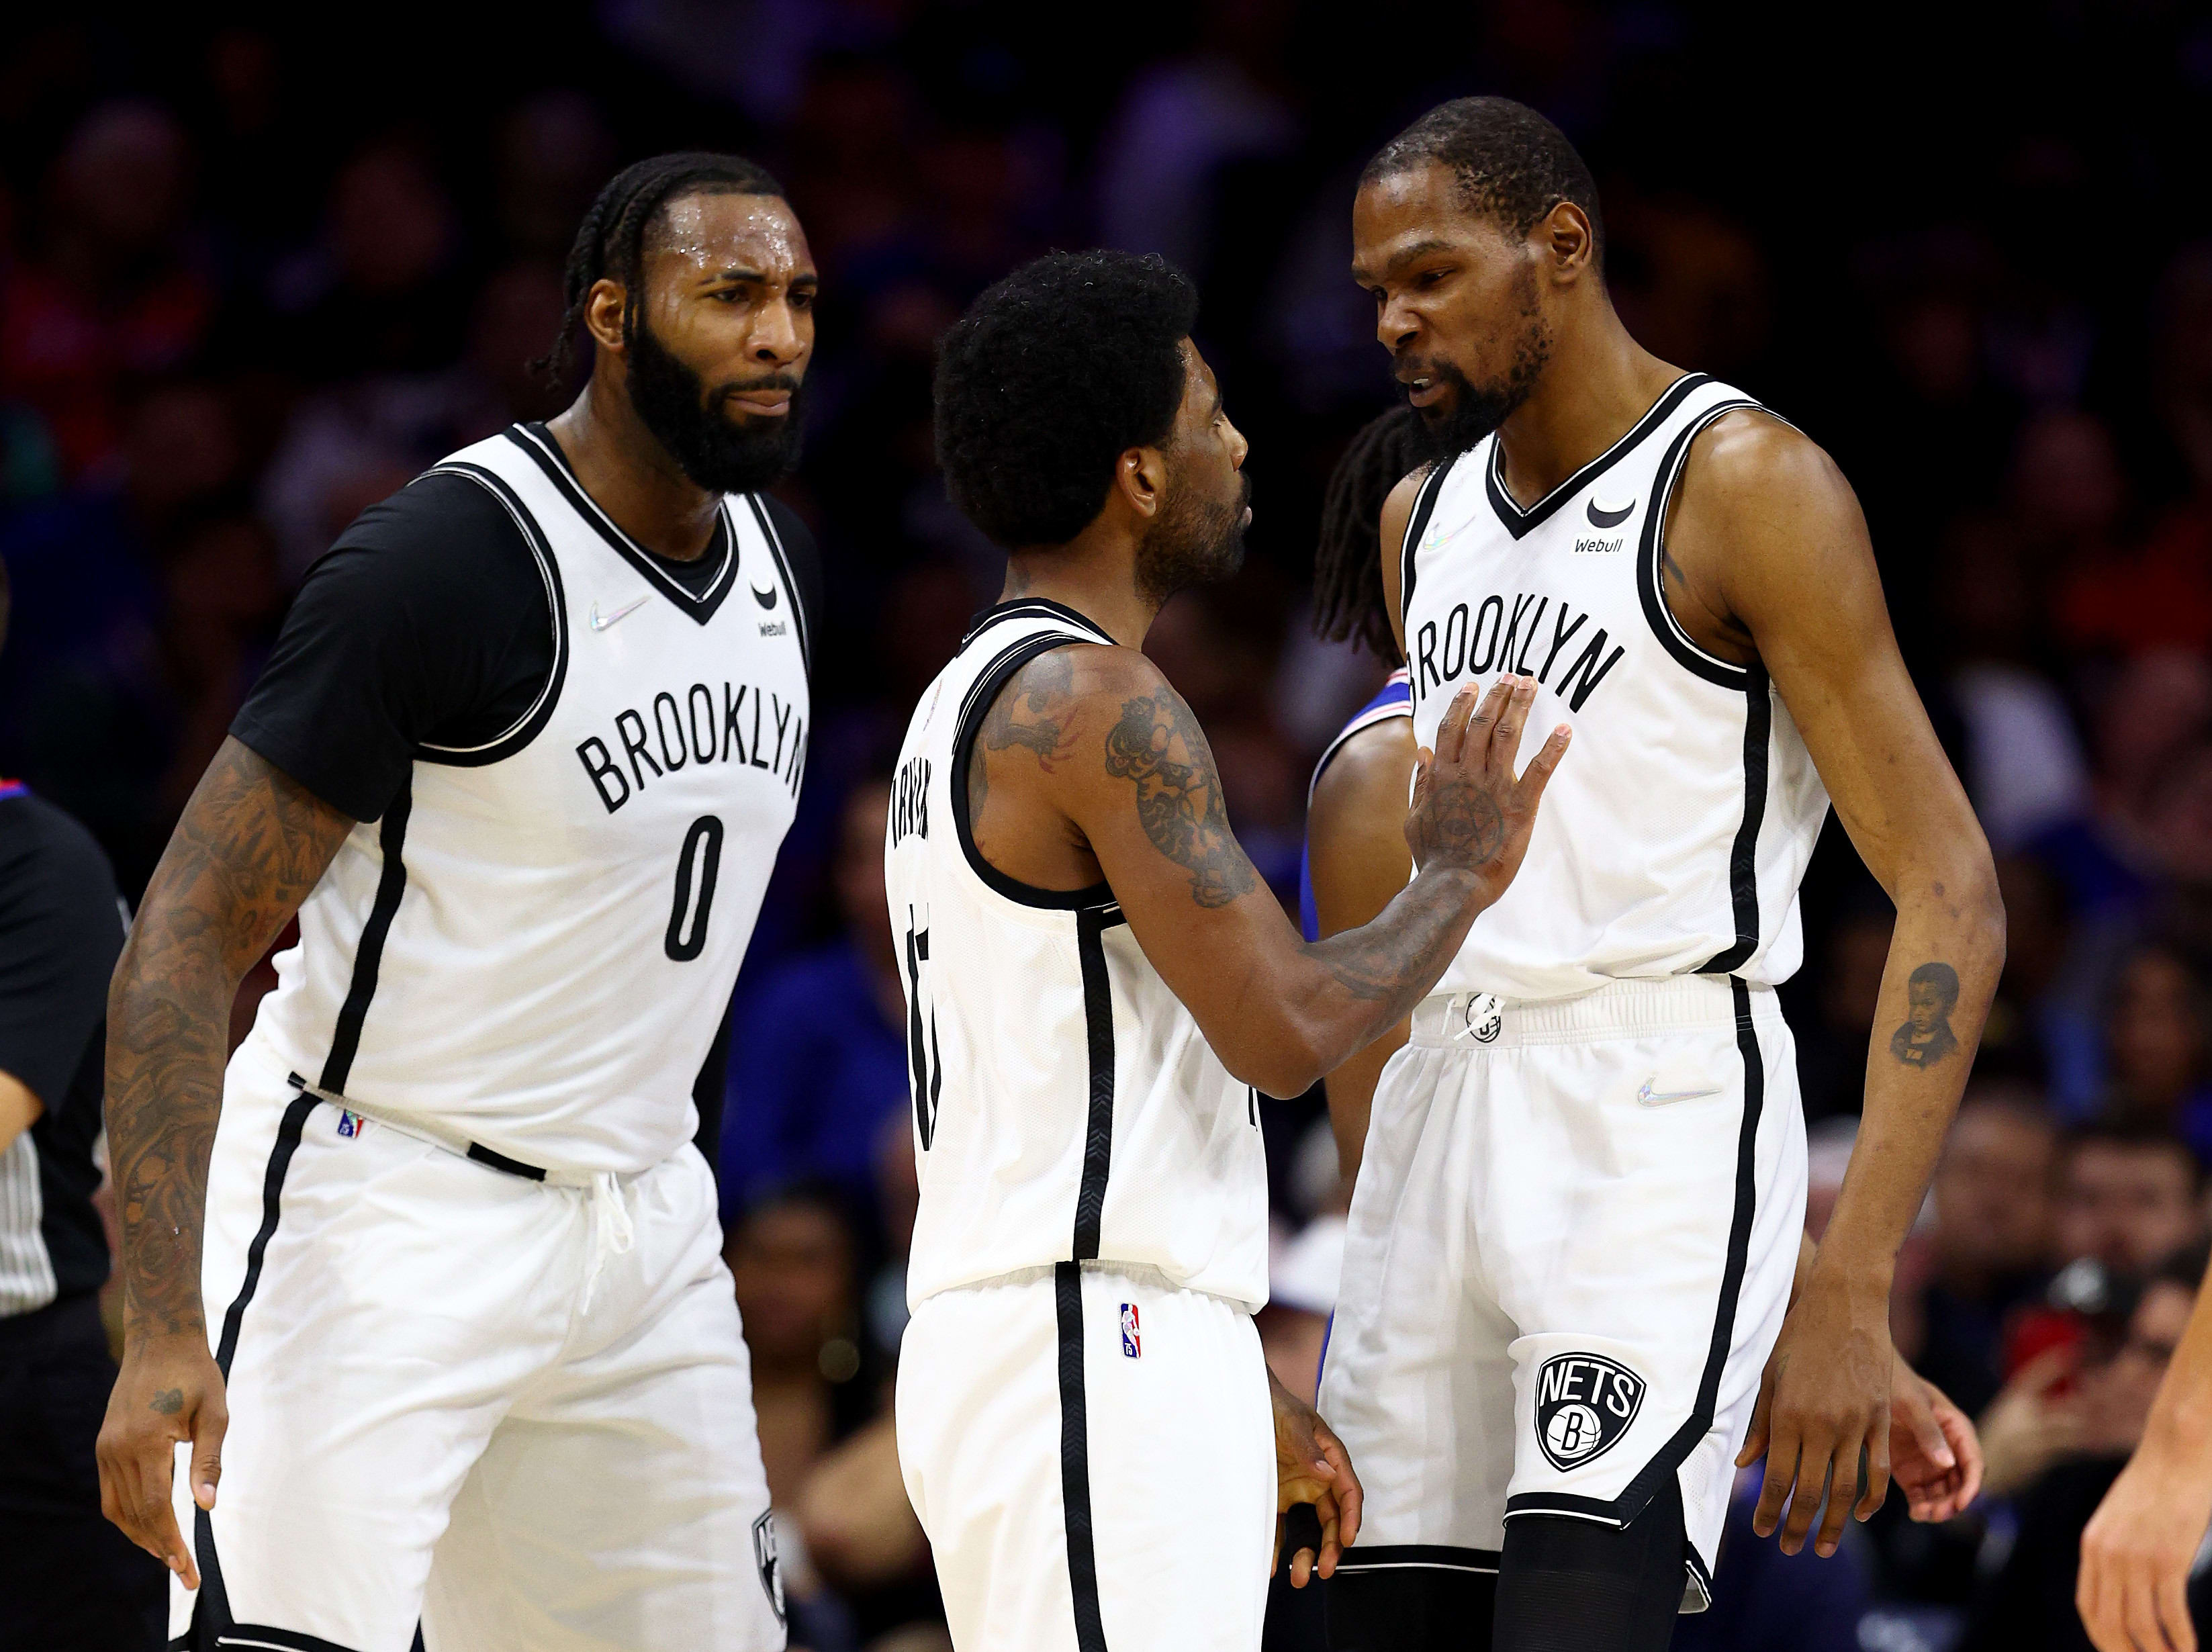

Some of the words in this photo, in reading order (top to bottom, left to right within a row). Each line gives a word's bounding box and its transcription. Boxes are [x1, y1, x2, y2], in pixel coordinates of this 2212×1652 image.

[1575, 539, 1623, 552] Webull
[664, 815, 723, 962] 0
[1539, 1360, 1634, 1418] NETS
[1561, 1412, 1583, 1451] B
